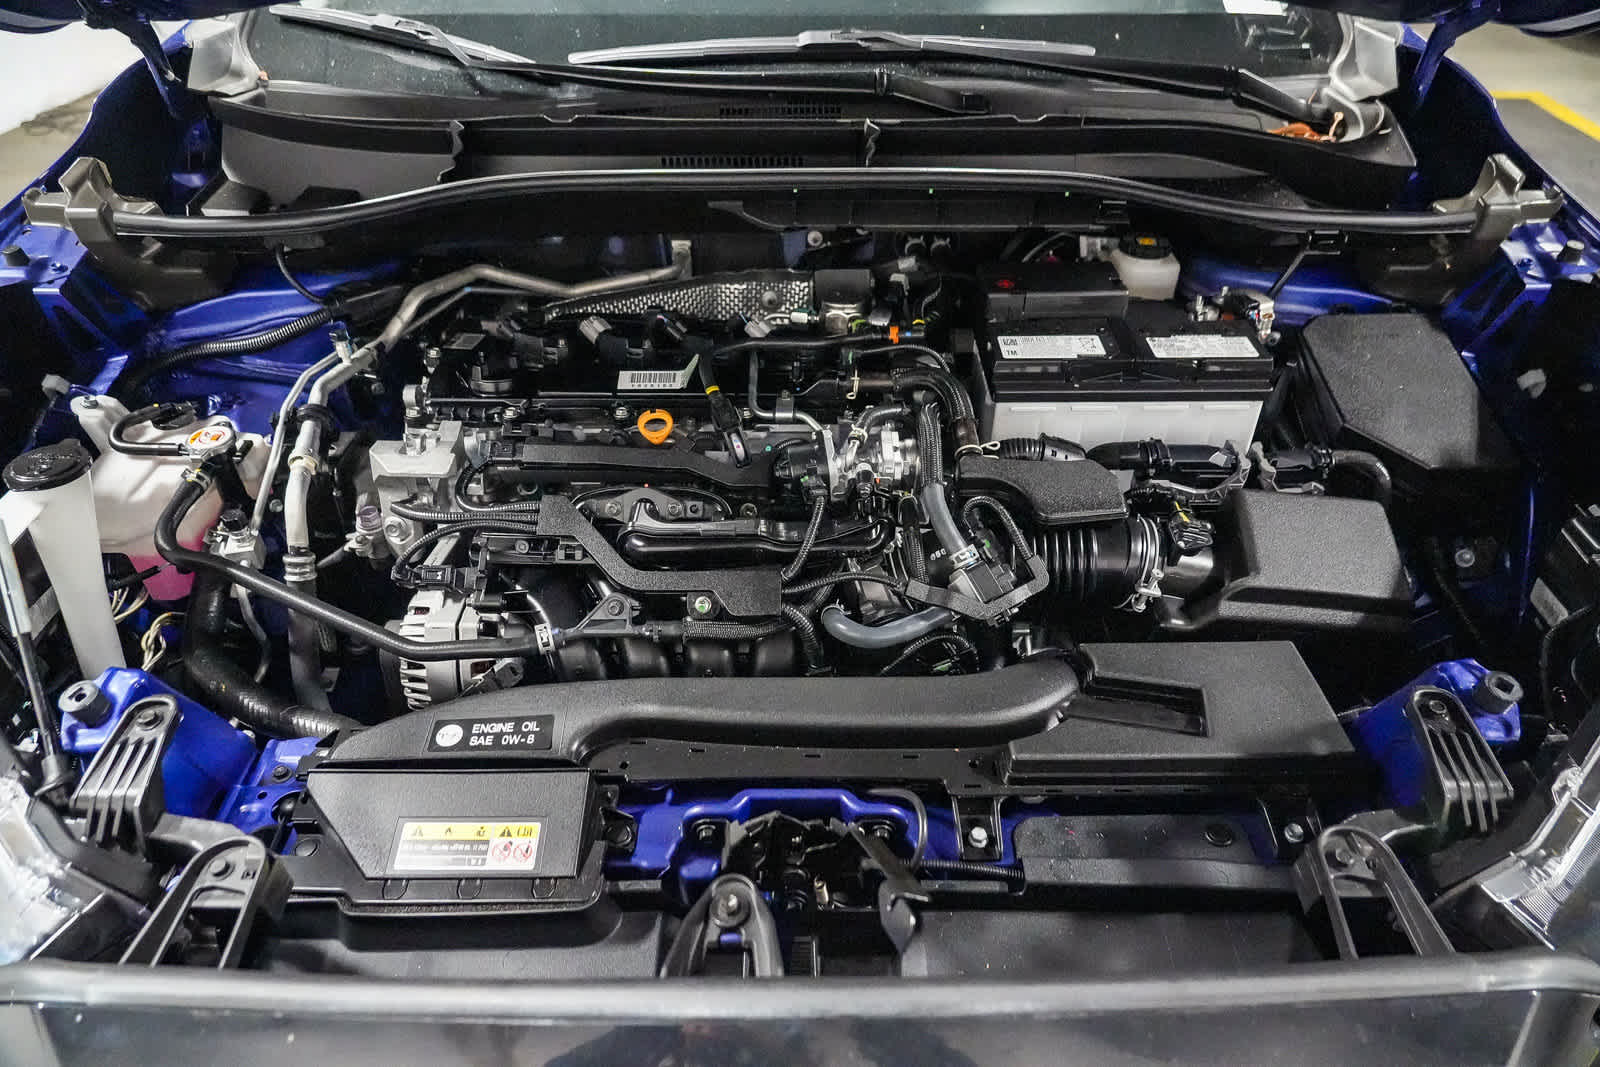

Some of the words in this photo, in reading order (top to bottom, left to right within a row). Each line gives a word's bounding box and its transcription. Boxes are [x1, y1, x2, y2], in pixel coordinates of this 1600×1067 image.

[471, 721, 515, 734] ENGINE
[521, 721, 540, 732] OIL
[469, 735, 494, 746] SAE
[501, 734, 535, 745] 0W-8
